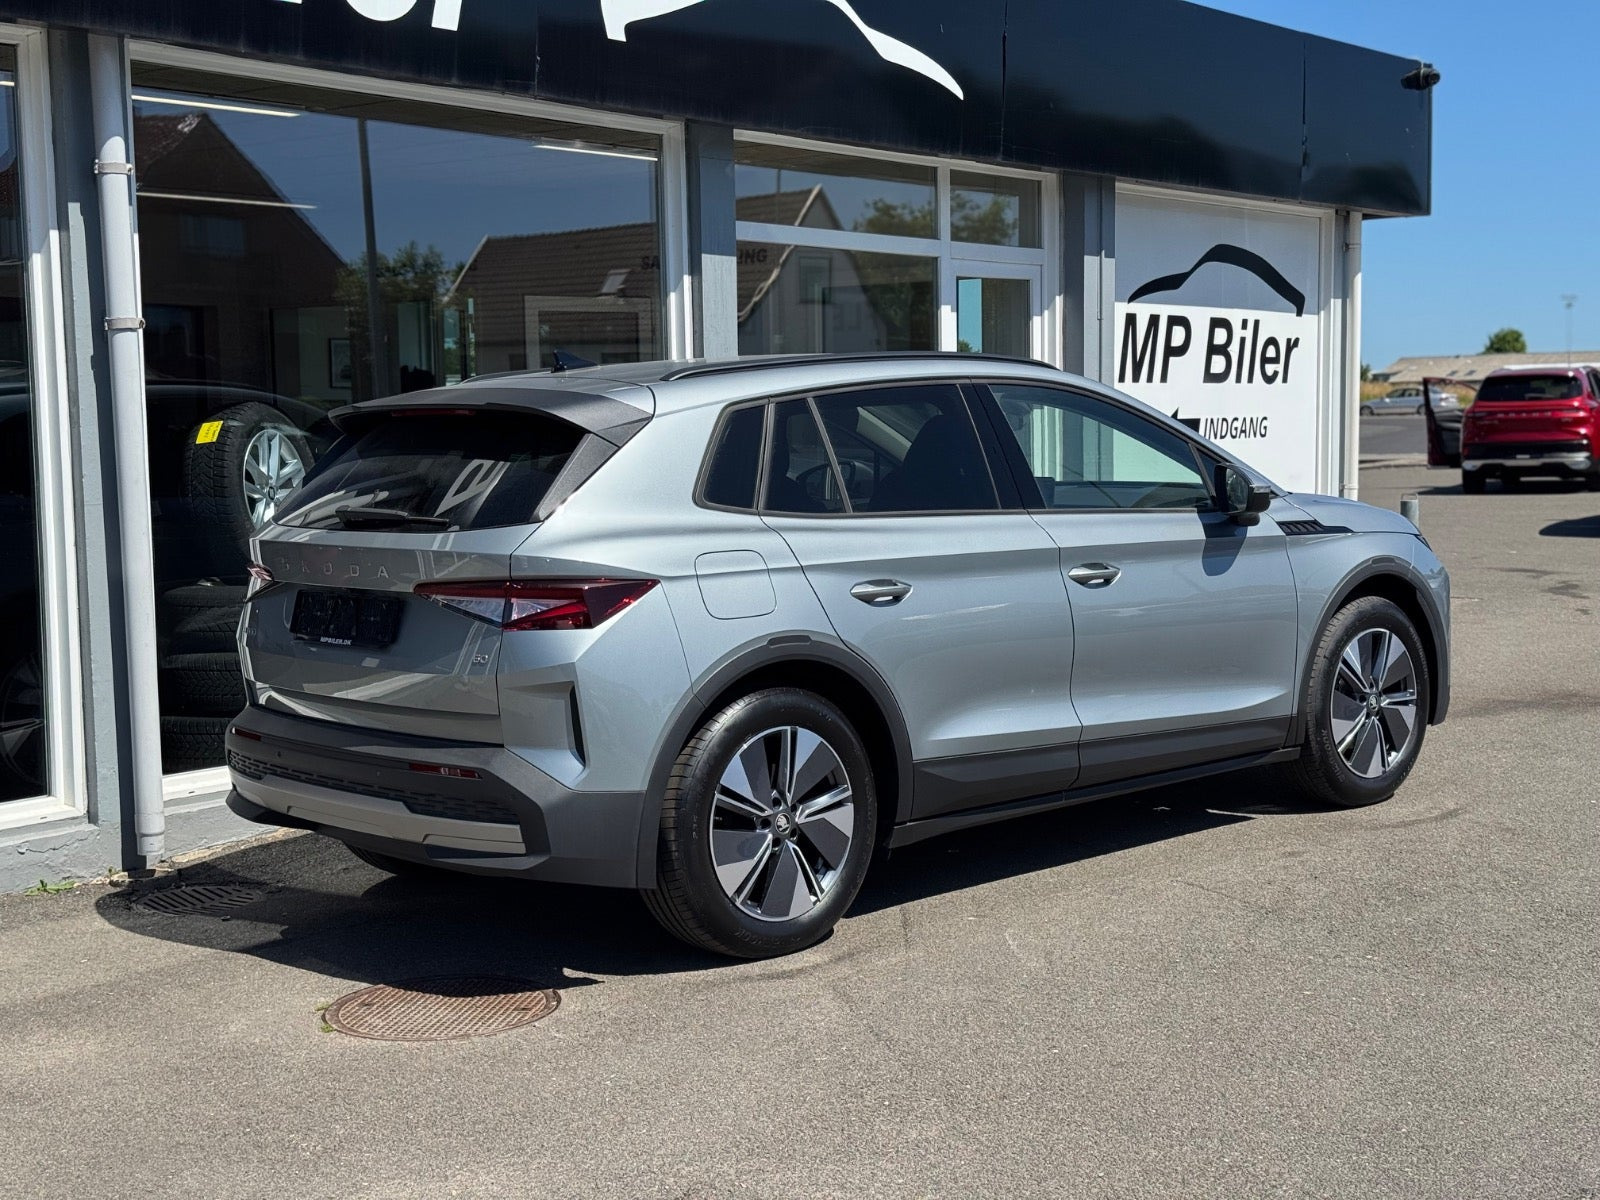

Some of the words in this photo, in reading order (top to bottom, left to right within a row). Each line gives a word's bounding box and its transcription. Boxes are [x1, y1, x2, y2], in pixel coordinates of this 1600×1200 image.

[1118, 312, 1192, 383] MP
[1202, 316, 1300, 385] Biler
[1203, 416, 1268, 439] INDGANG
